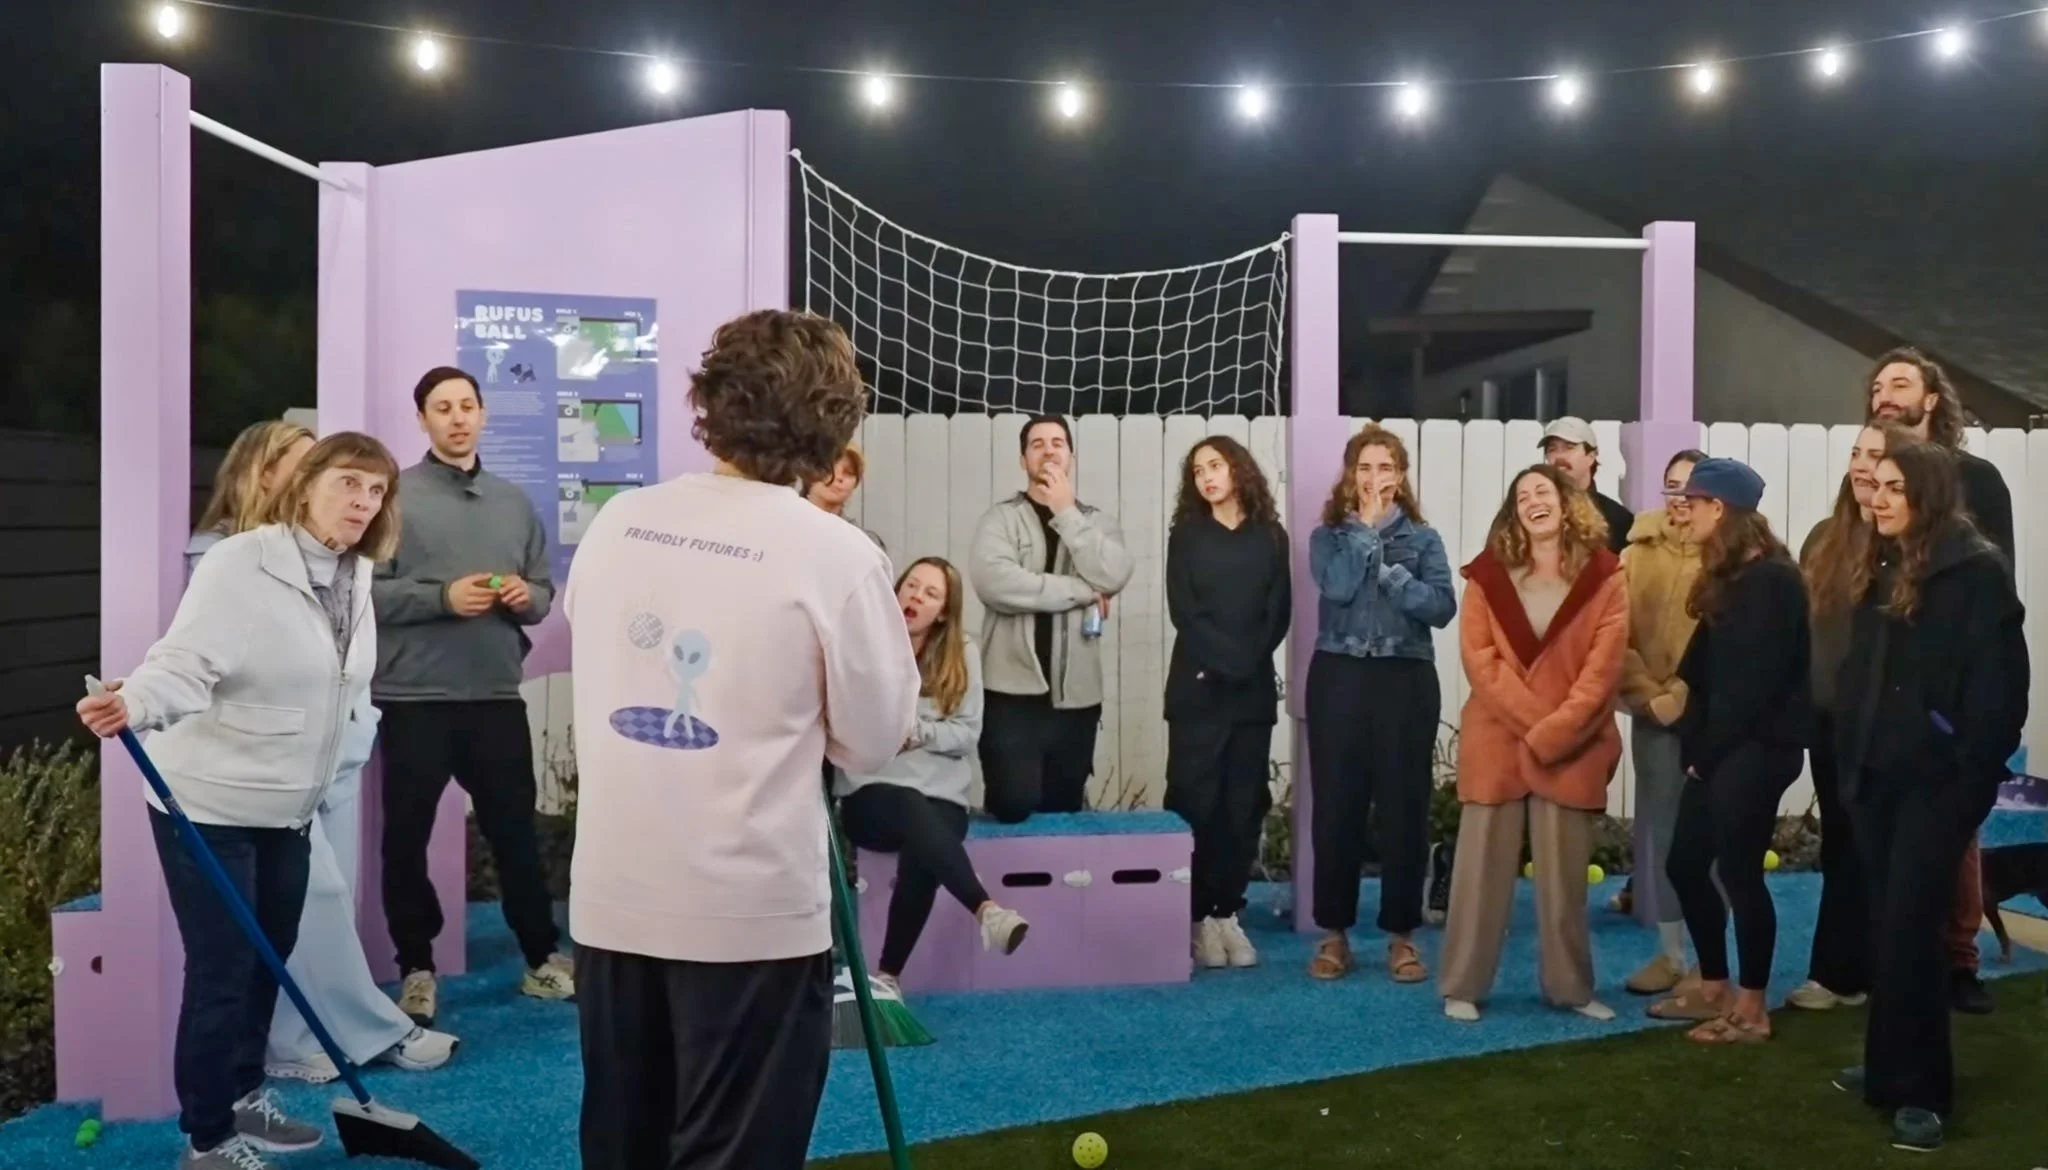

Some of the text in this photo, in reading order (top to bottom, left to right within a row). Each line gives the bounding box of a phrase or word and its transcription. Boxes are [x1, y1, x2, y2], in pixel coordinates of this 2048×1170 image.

[474, 305, 544, 322] RUFUS
[474, 323, 527, 340] BALL
[624, 527, 688, 547] FRIENDLY
[689, 538, 751, 559] FUTURES
